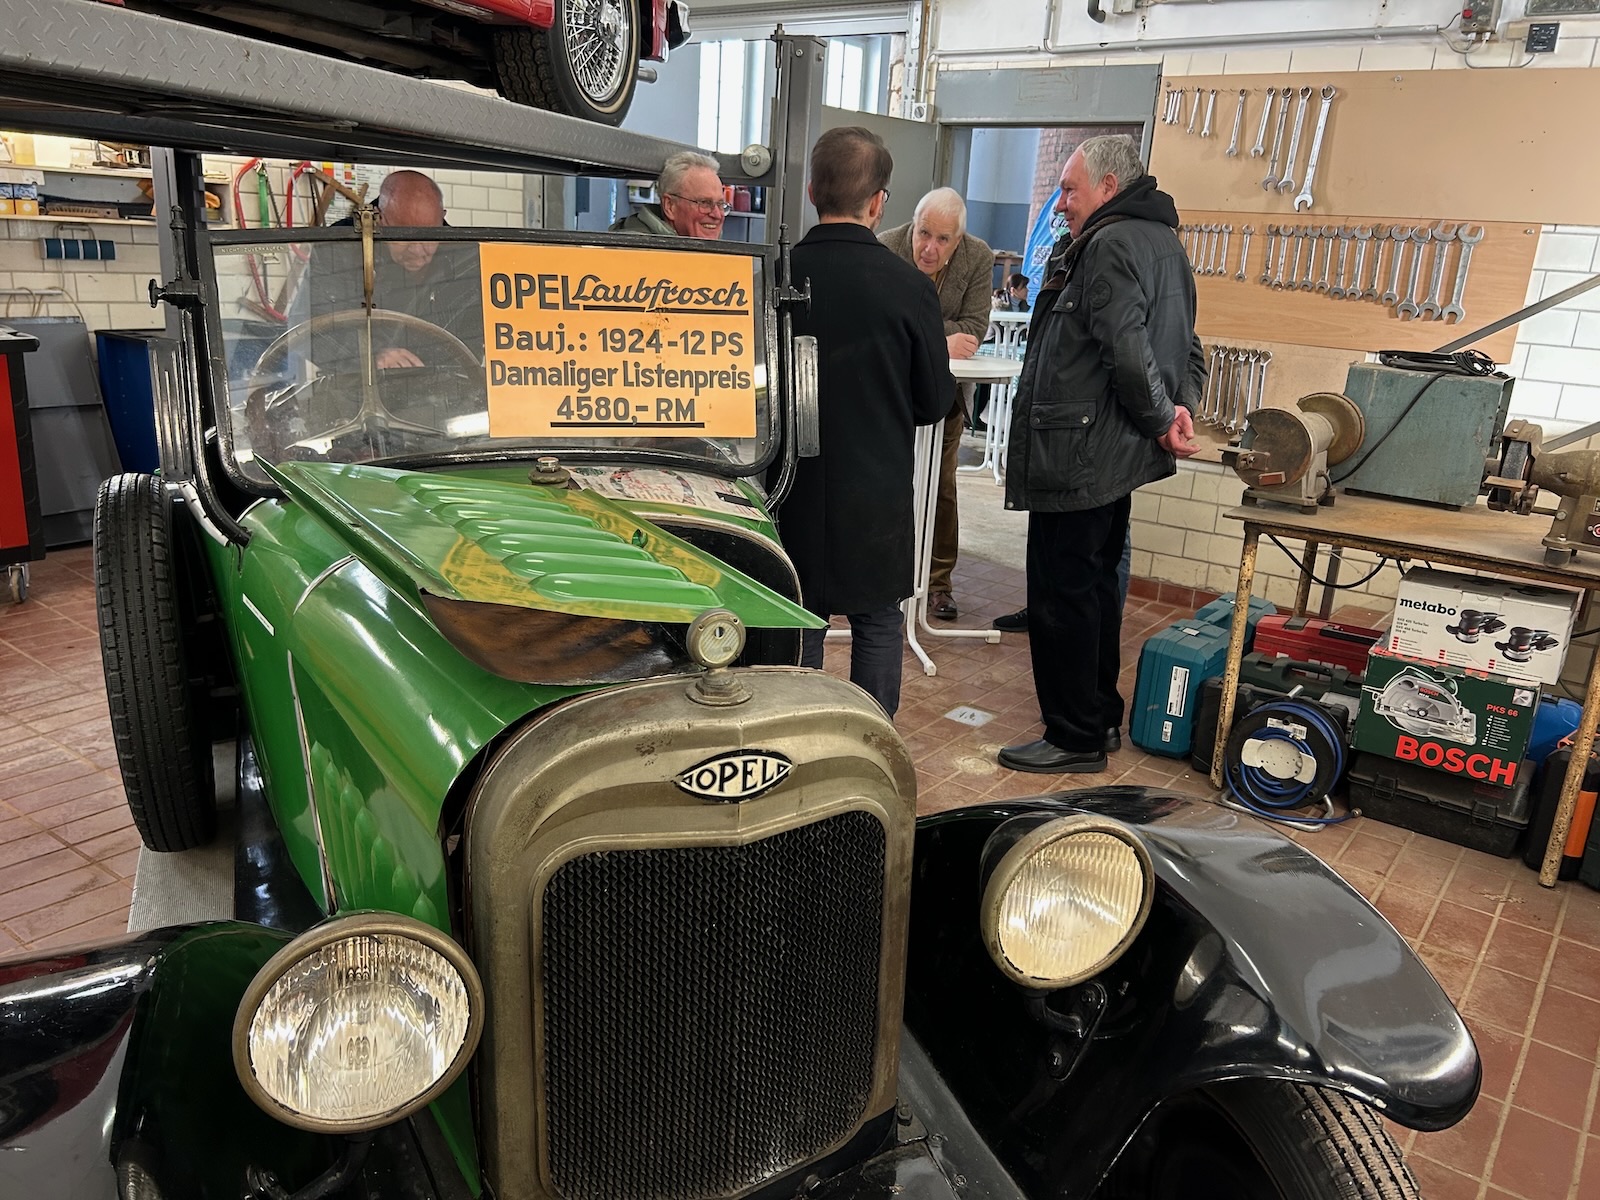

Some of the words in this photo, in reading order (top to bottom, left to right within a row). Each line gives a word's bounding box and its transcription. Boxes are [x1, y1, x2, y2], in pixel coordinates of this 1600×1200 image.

[489, 272, 580, 311] OPEL
[572, 274, 749, 313] Laubfrosch
[494, 322, 588, 355] Bauj.:
[711, 331, 744, 357] PS
[490, 359, 619, 394] Damaliger
[622, 360, 751, 397] Listenpreis
[655, 398, 696, 422] RM
[1399, 598, 1457, 616] metabo
[1486, 703, 1506, 715] PKS
[1507, 708, 1519, 718] 66
[695, 758, 775, 793] OPEL
[1394, 734, 1518, 786] BOSCH
